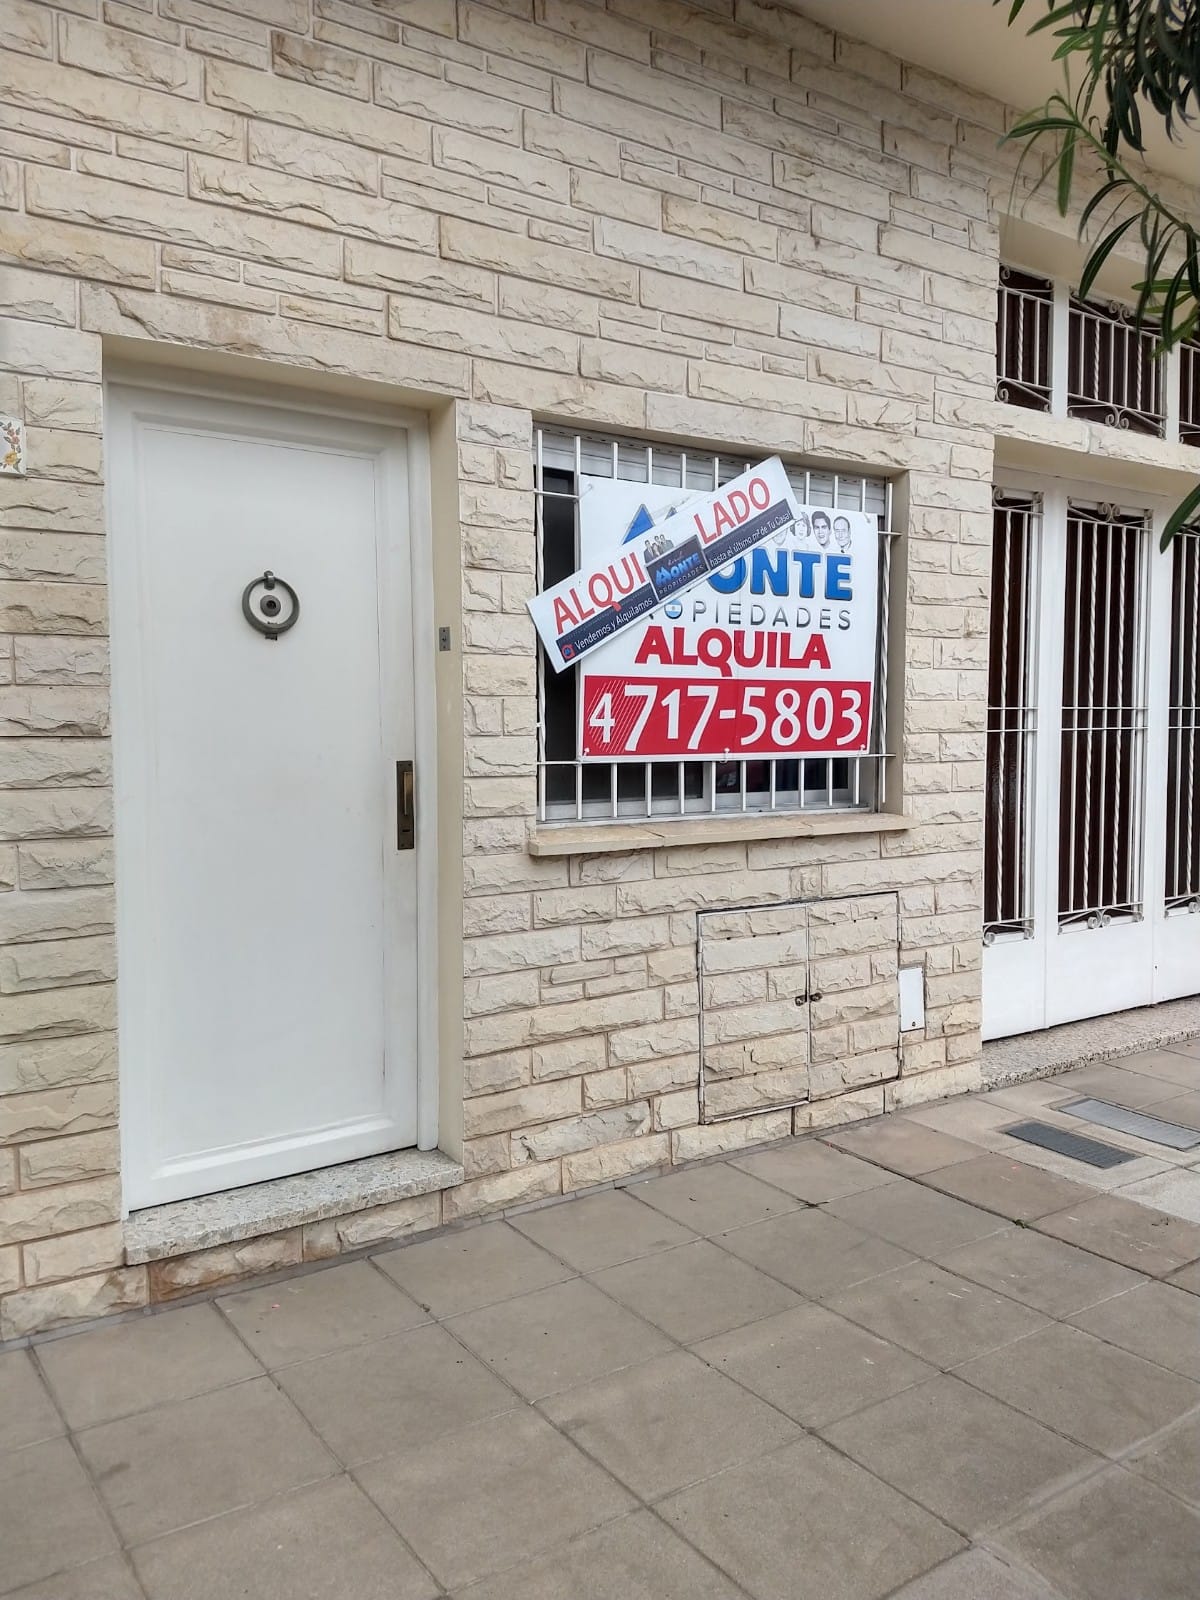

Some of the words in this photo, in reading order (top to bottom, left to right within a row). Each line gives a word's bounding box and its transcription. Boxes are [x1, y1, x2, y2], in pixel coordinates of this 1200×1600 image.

[552, 553, 647, 635] ALQUI
[693, 477, 771, 545] LADO
[656, 552, 700, 585] MONTE
[709, 552, 727, 567] hasta
[727, 546, 734, 556] el
[733, 536, 752, 553] último
[760, 526, 768, 536] de
[767, 520, 776, 530] Tu
[659, 564, 704, 594] PROPIEDADES
[704, 546, 853, 601] ONTE
[574, 624, 611, 650] Vendemos
[616, 597, 653, 625] Alquilamos
[635, 625, 832, 677] ALQUILA
[589, 684, 863, 752] 4717-5803
